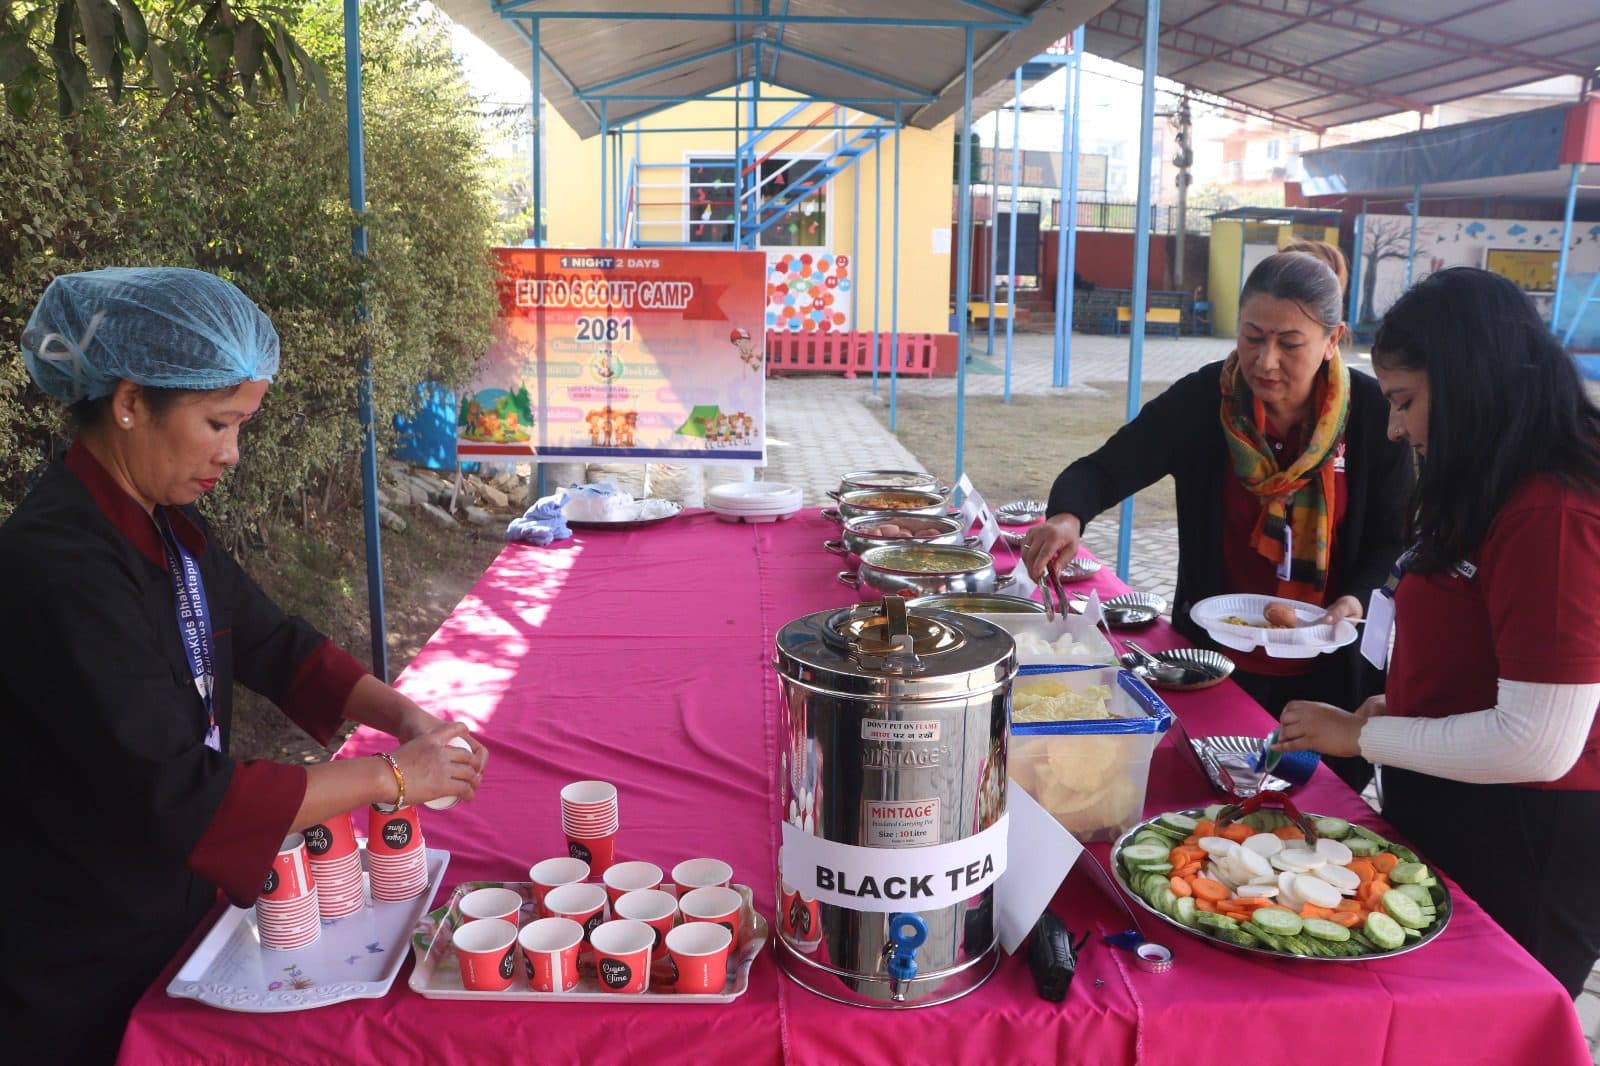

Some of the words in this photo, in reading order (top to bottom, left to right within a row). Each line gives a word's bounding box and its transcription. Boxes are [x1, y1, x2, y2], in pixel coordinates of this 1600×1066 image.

[561, 258, 569, 268] 1
[571, 258, 613, 268] NIGHT
[616, 259, 624, 268] 2
[627, 259, 660, 268] DAYS
[516, 280, 569, 307] EURO
[571, 280, 637, 308] SCOUT
[639, 282, 694, 309] CAMP
[576, 317, 632, 341] 2081
[186, 621, 204, 675] EuroKids
[867, 721, 887, 729] DON'T
[878, 829, 894, 838] Size
[910, 829, 927, 837] Litre
[816, 865, 934, 899] BLACK
[945, 853, 994, 891] TEA
